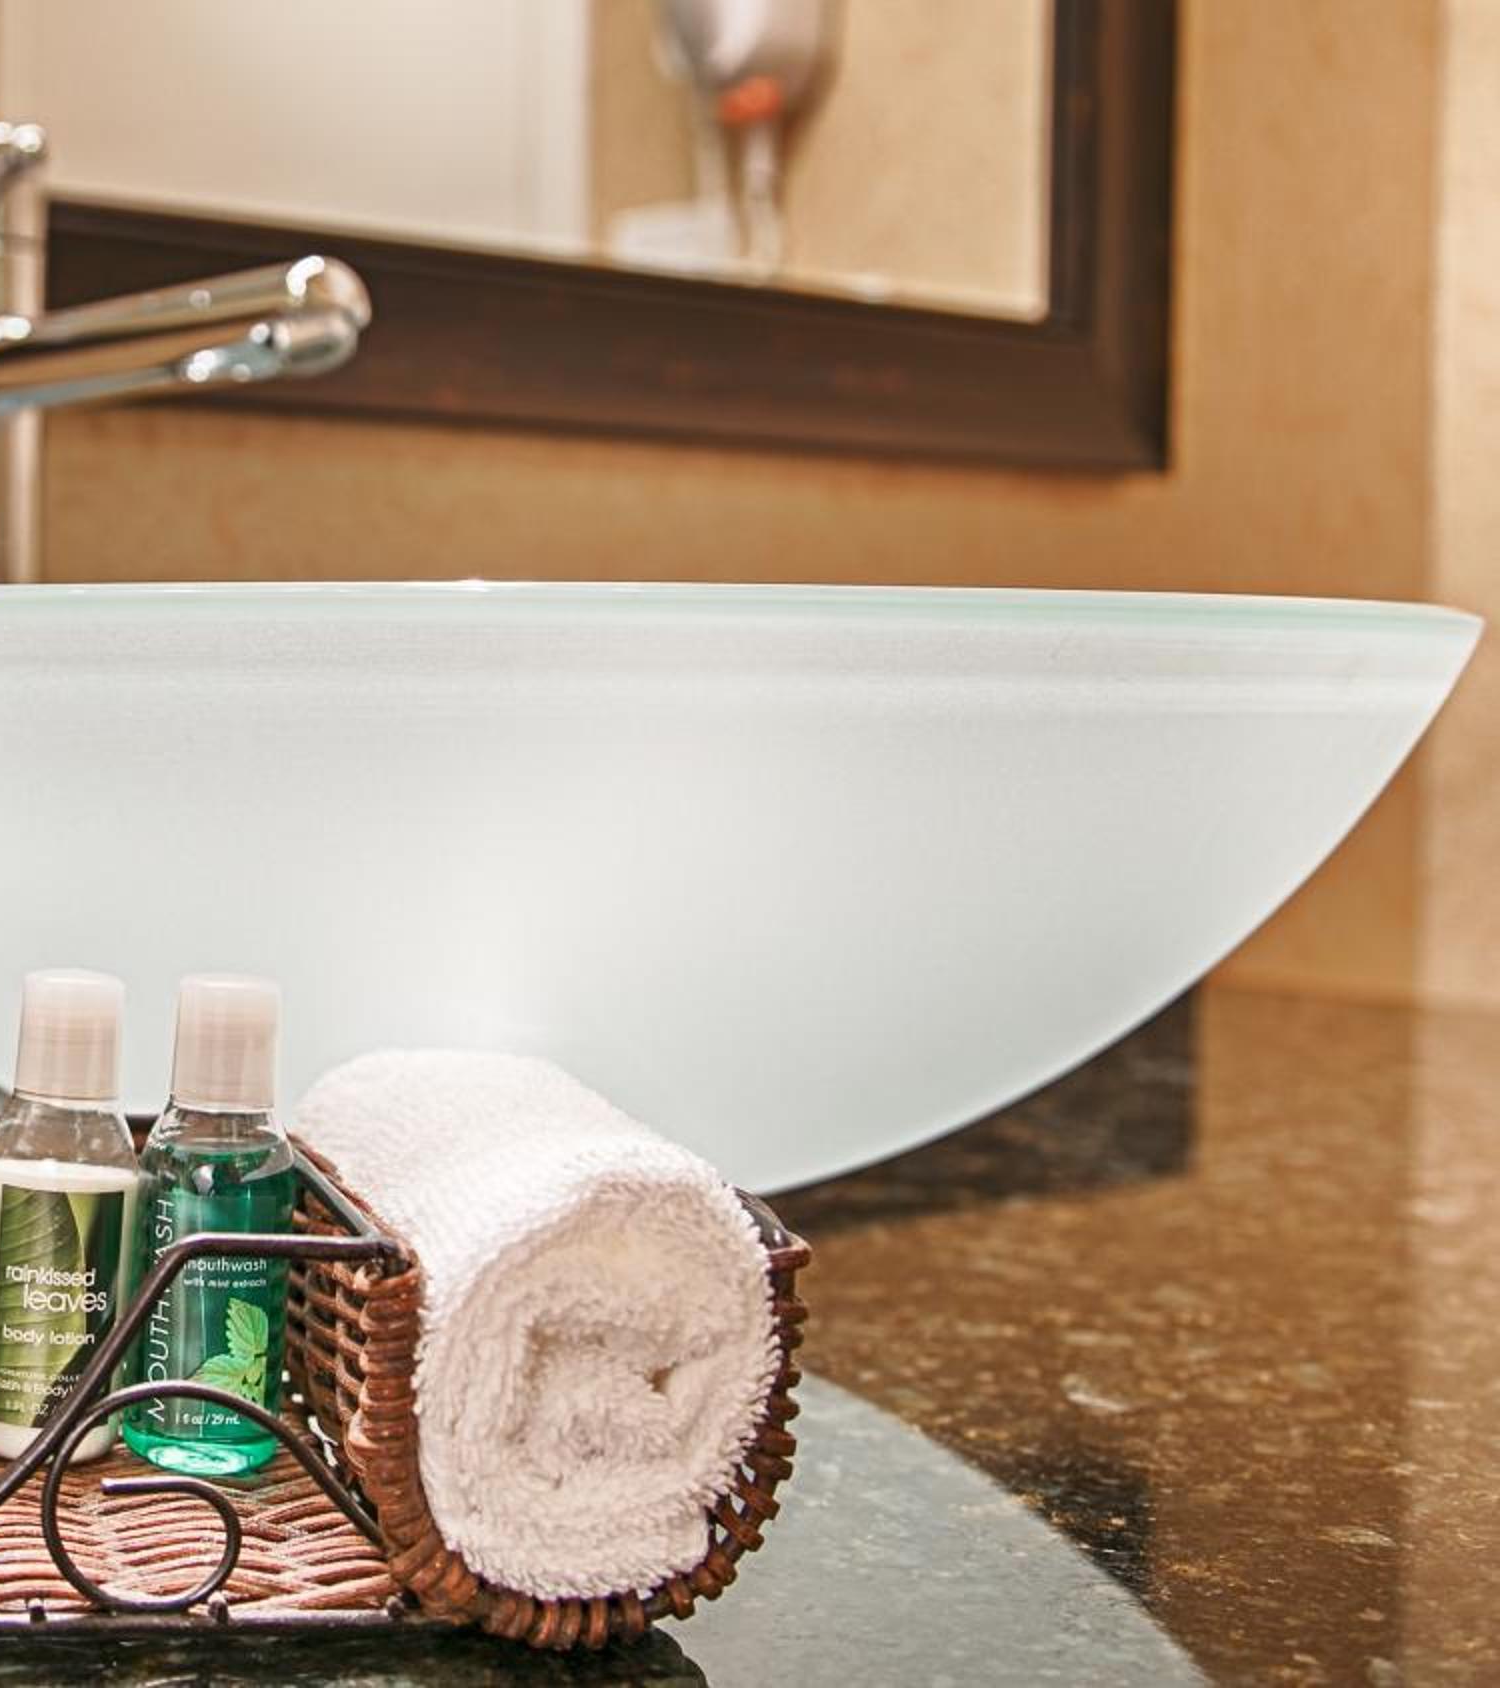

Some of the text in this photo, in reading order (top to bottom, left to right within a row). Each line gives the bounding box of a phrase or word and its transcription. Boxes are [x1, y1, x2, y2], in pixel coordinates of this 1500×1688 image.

[5, 1263, 97, 1287] rainkissed
[183, 1256, 267, 1273] mouthwash
[23, 1283, 108, 1313] leaves
[147, 1199, 174, 1423] MOUTHASH
[2, 1323, 96, 1346] body lotion
[211, 1413, 224, 1426] 29
